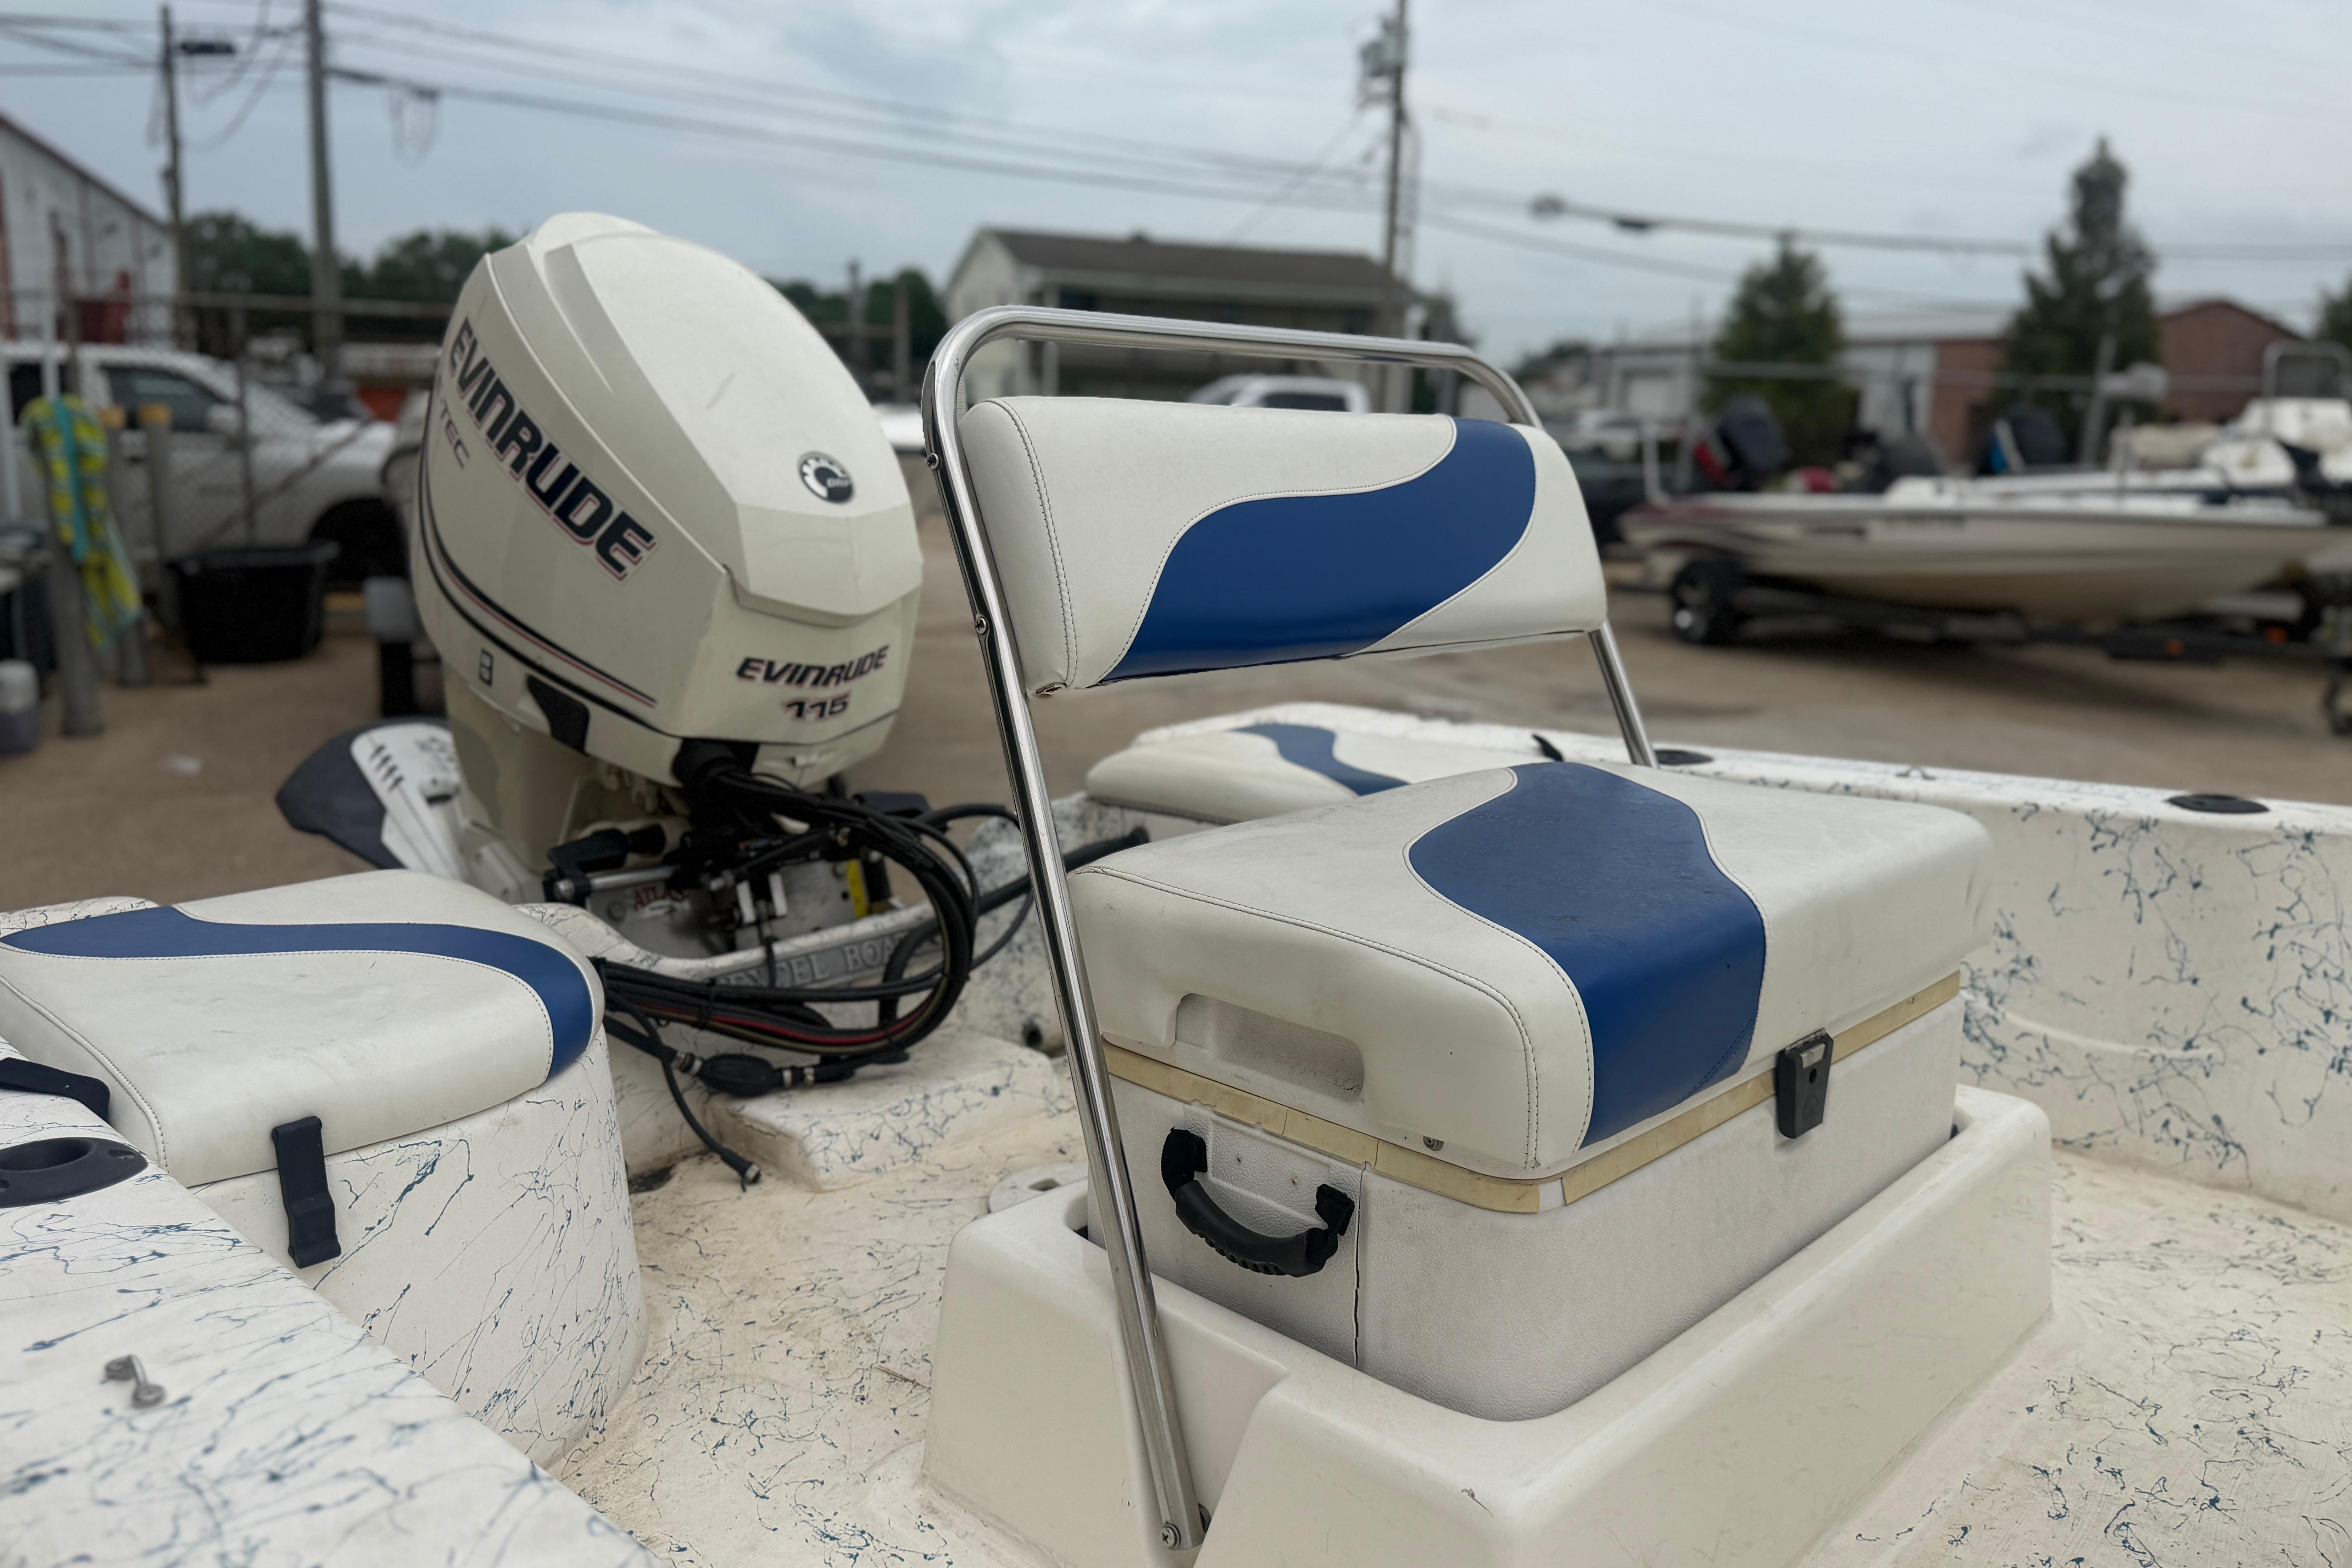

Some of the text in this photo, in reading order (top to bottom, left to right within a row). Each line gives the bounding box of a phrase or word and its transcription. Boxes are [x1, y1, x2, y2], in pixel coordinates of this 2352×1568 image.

[450, 317, 656, 581] EVINRUDE
[737, 645, 889, 688] EVINRUDE
[784, 693, 851, 721] 115
